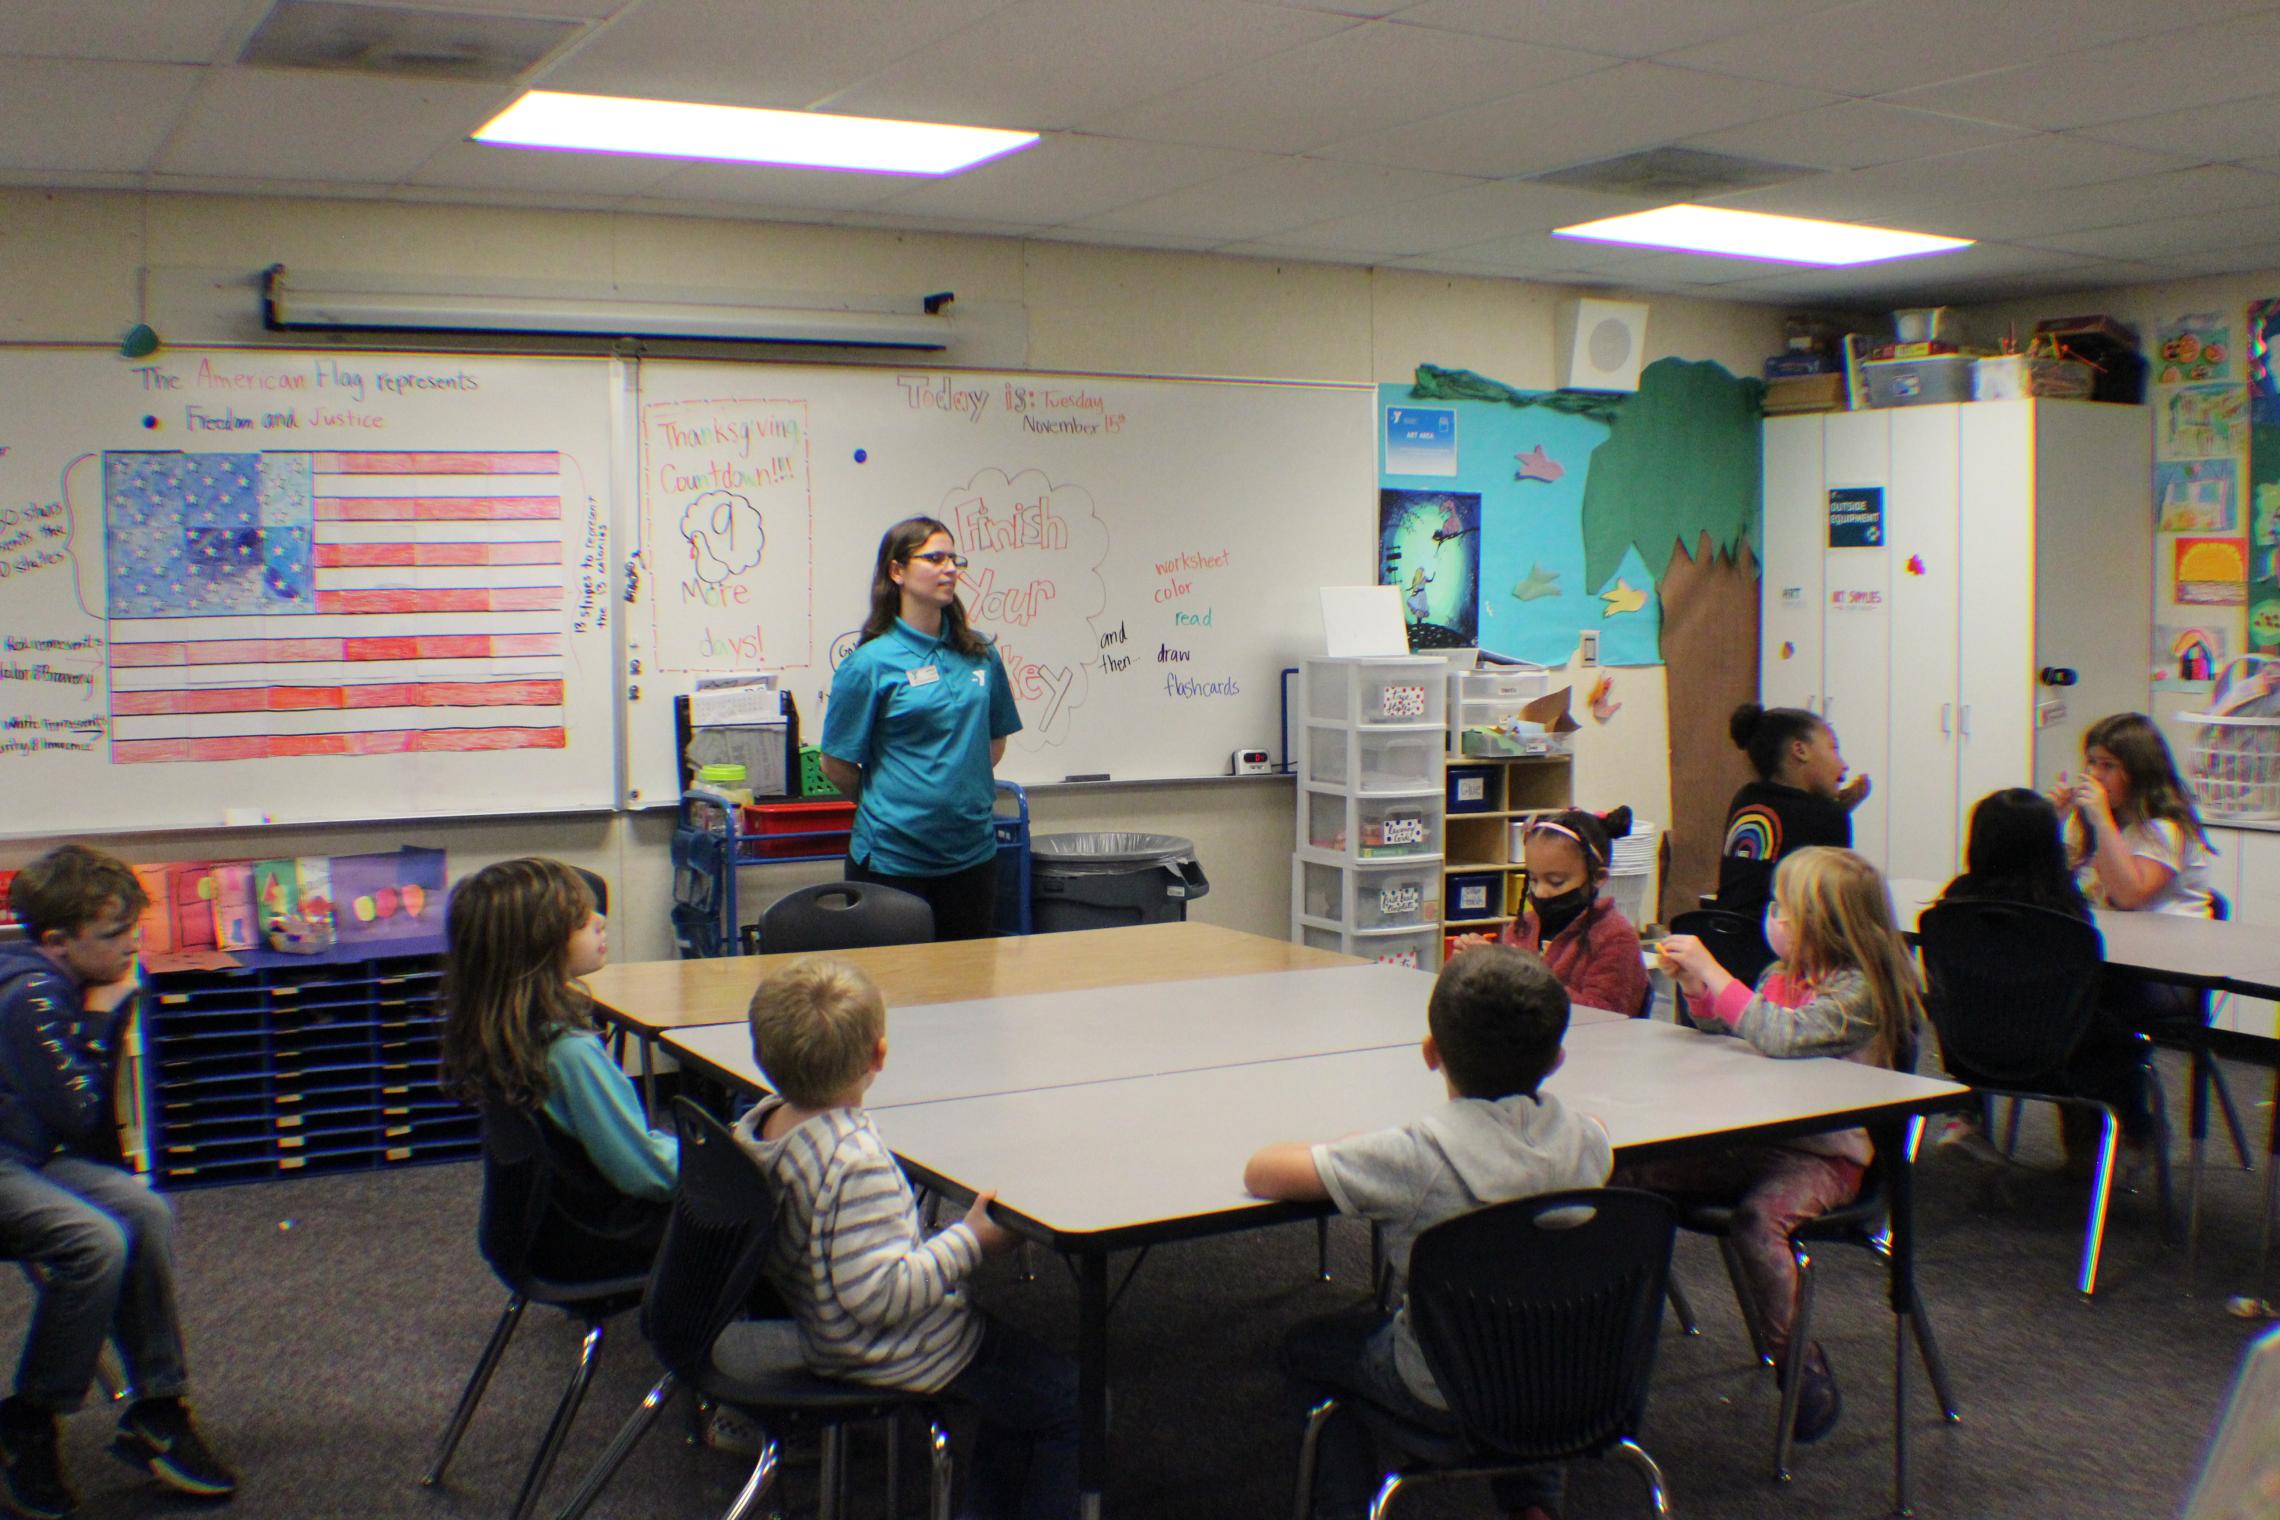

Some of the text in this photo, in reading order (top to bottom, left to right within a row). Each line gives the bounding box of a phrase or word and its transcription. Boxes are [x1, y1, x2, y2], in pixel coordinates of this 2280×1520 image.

[129, 357, 479, 402] The American Flag represents
[896, 375, 990, 424] Today
[1040, 389, 1105, 413] Tuesday
[262, 405, 300, 429] and
[309, 407, 384, 429] Justice
[1022, 414, 1100, 434] November
[656, 416, 799, 459] Thanksgiving
[1830, 513, 1880, 526] EQUIPMENT
[1831, 502, 1867, 512] OUTSIDE
[710, 501, 734, 552] 9
[955, 496, 1068, 552] Finish
[573, 496, 598, 634] 13 stripes to represent
[1155, 548, 1230, 575] worksheet
[681, 577, 751, 608] More
[957, 567, 1056, 627] Your
[1154, 578, 1192, 603] color
[1175, 607, 1212, 626] read
[700, 624, 765, 664] days!
[1100, 620, 1128, 649] and
[1157, 643, 1190, 663] draw
[1164, 672, 1240, 699] flashcards
